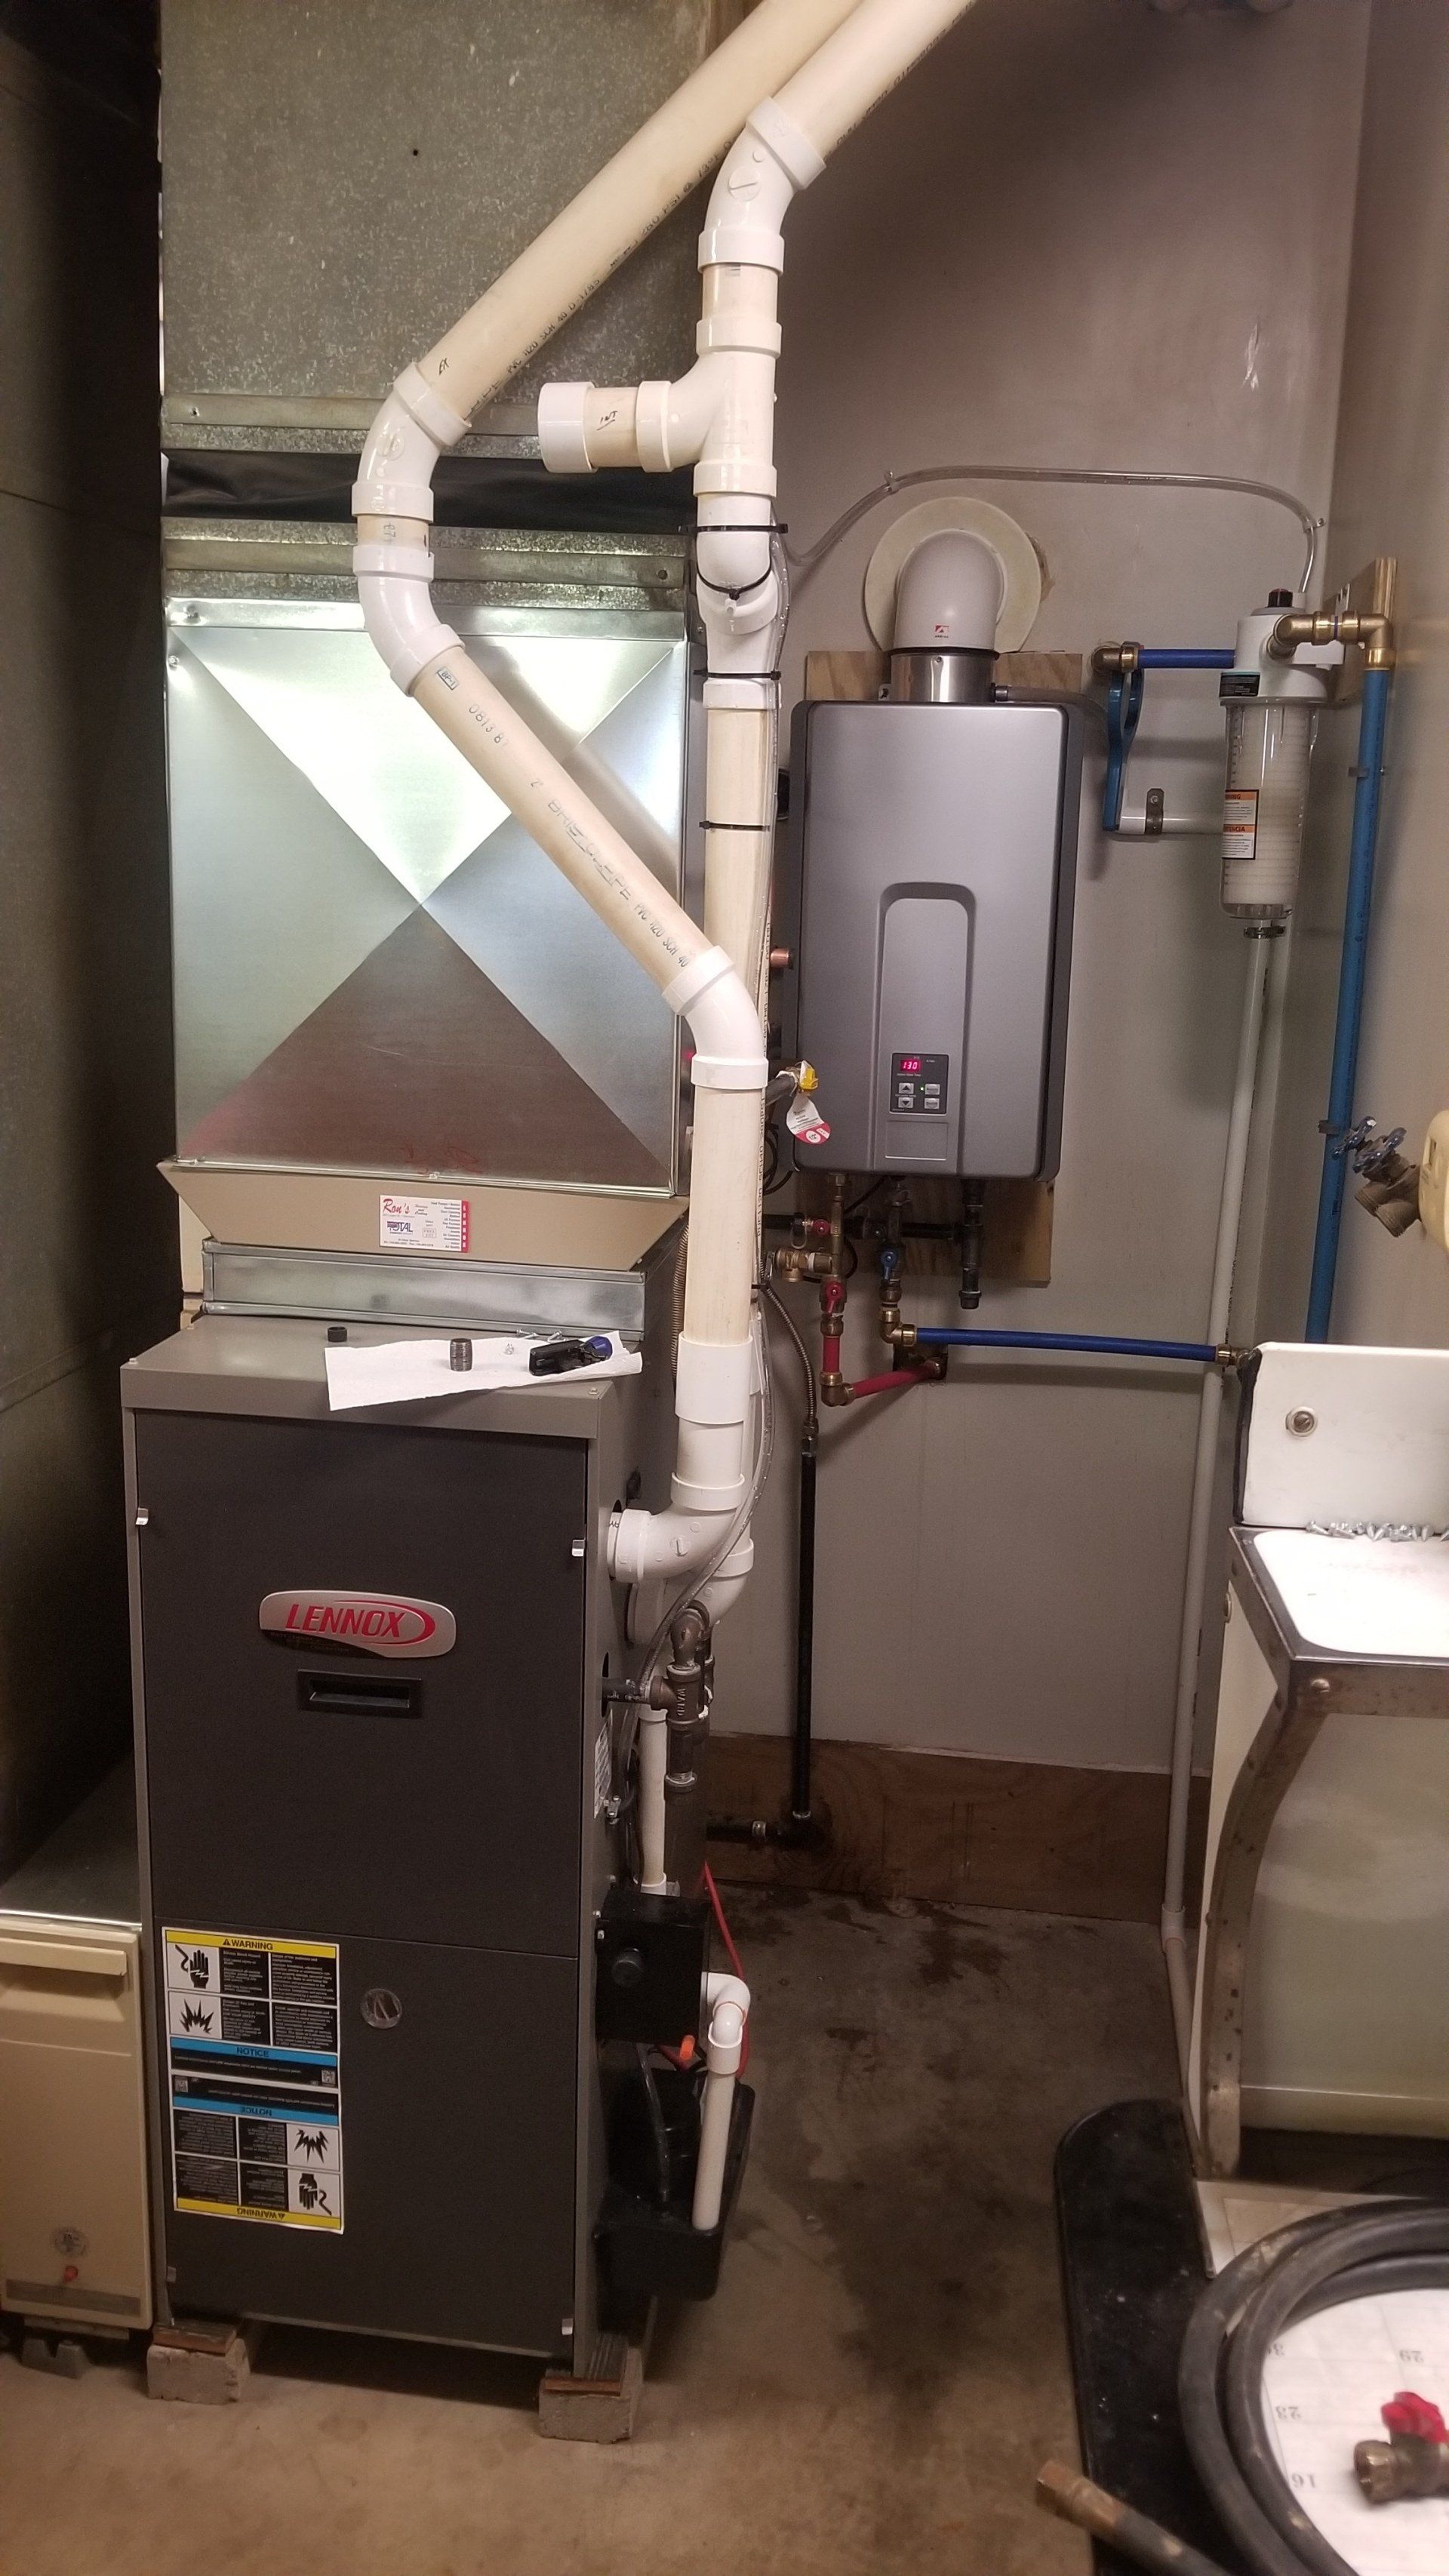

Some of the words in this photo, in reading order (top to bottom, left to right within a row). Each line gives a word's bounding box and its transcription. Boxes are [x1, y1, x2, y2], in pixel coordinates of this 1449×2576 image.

[661, 937, 679, 956] SCH
[675, 954, 690, 968] 40
[903, 1061, 918, 1069] 130
[383, 1198, 410, 1214] Ron's
[285, 1604, 407, 1638] LENNOX
[676, 1688, 686, 1716] WARD
[231, 1939, 274, 1950] WARNING
[236, 2046, 269, 2058] NOTICE
[240, 2106, 272, 2117] NOTICE
[236, 2207, 277, 2220] WARNING
[1398, 2349, 1425, 2363] 29
[1275, 2405, 1303, 2421] 23
[1291, 2473, 1317, 2489] 16
